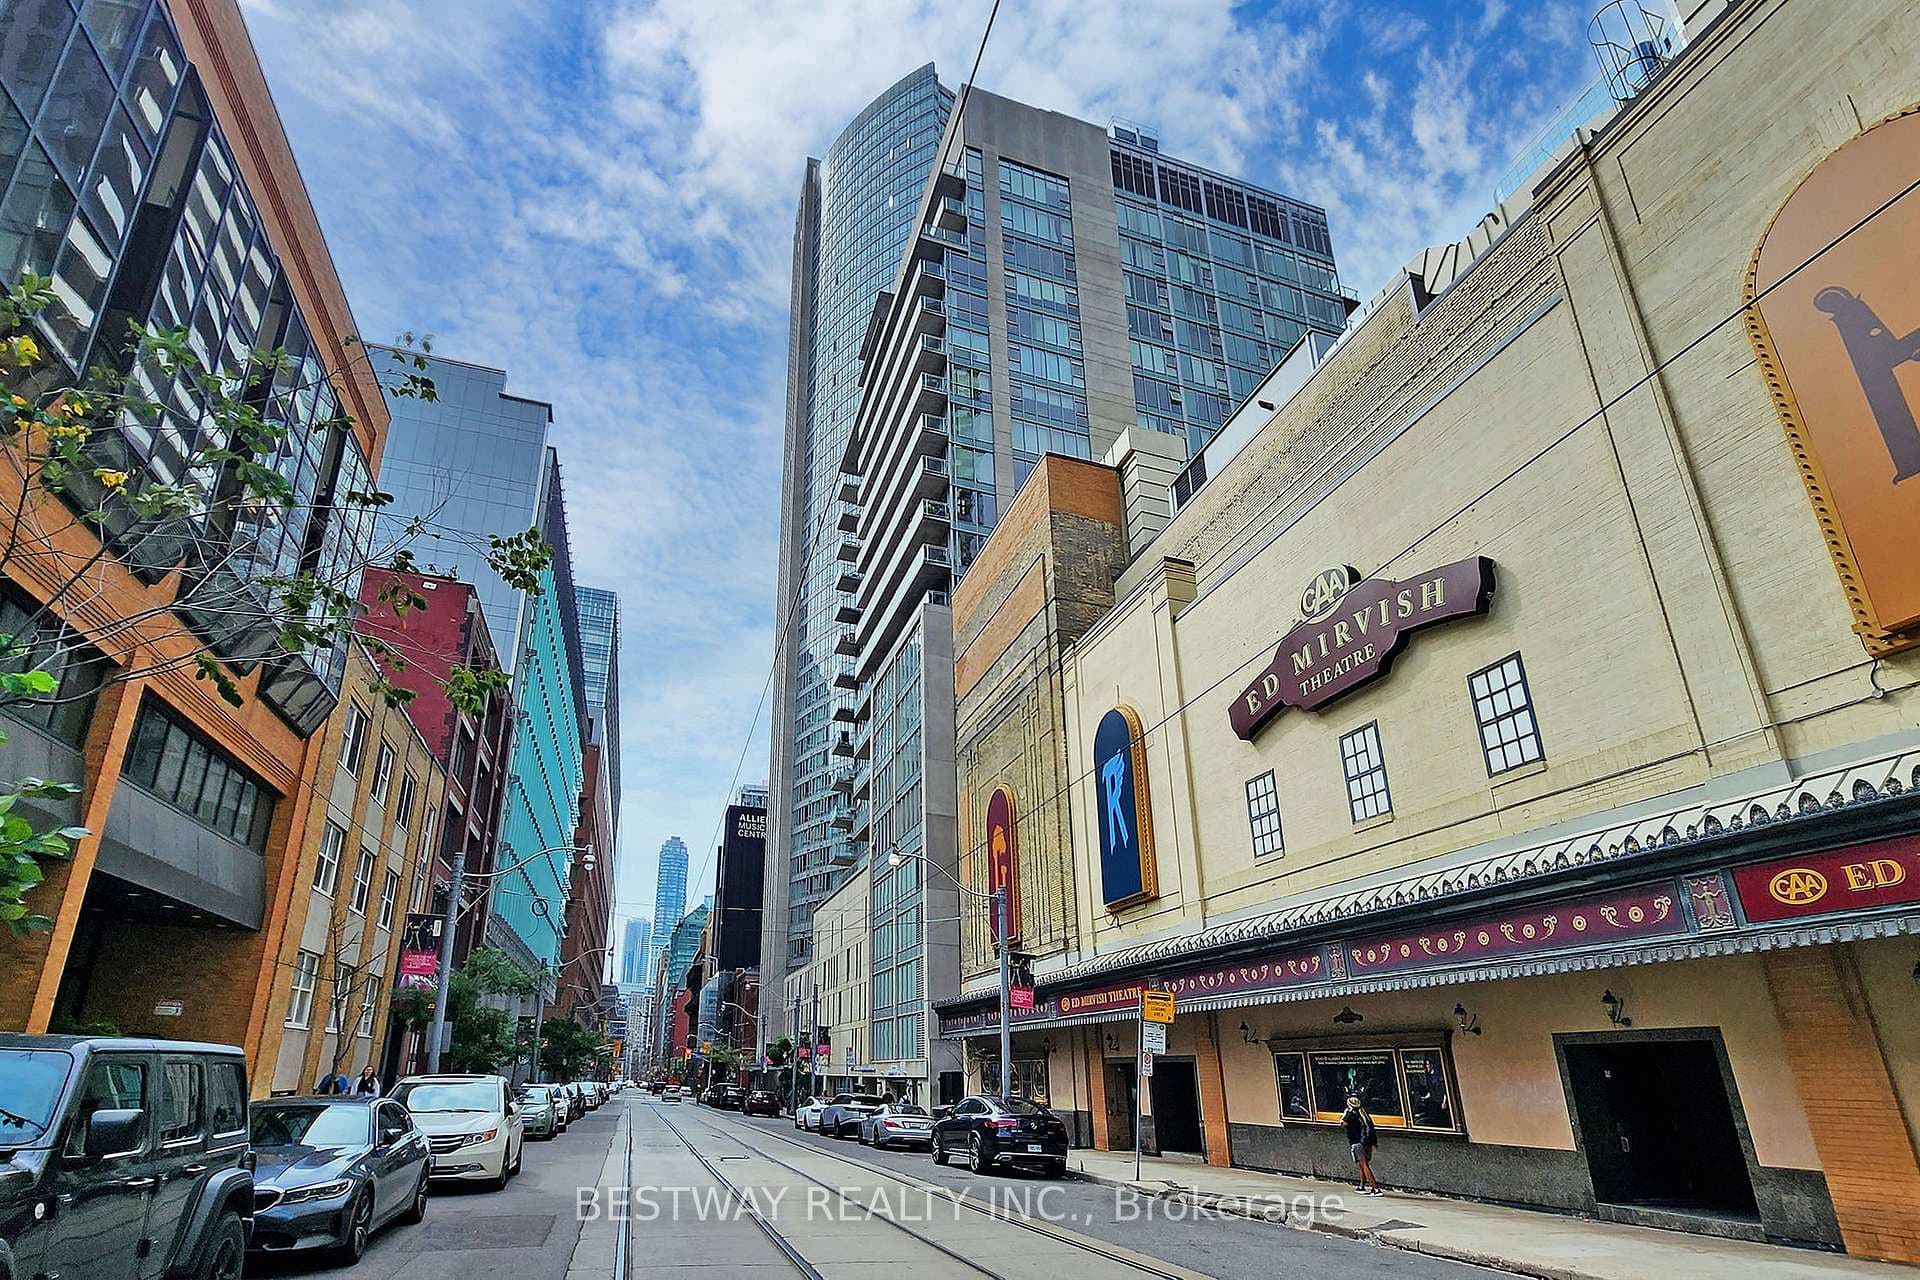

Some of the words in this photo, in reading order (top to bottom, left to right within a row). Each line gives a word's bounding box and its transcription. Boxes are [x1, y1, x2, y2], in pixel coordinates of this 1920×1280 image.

[1302, 569, 1345, 615] CAA
[1246, 673, 1281, 716] ED
[1291, 577, 1447, 677] MIRVISH
[1299, 642, 1377, 697] THEATRE
[738, 822, 766, 831] MUSIC
[1775, 873, 1821, 900] CAA
[1841, 859, 1906, 892] ED
